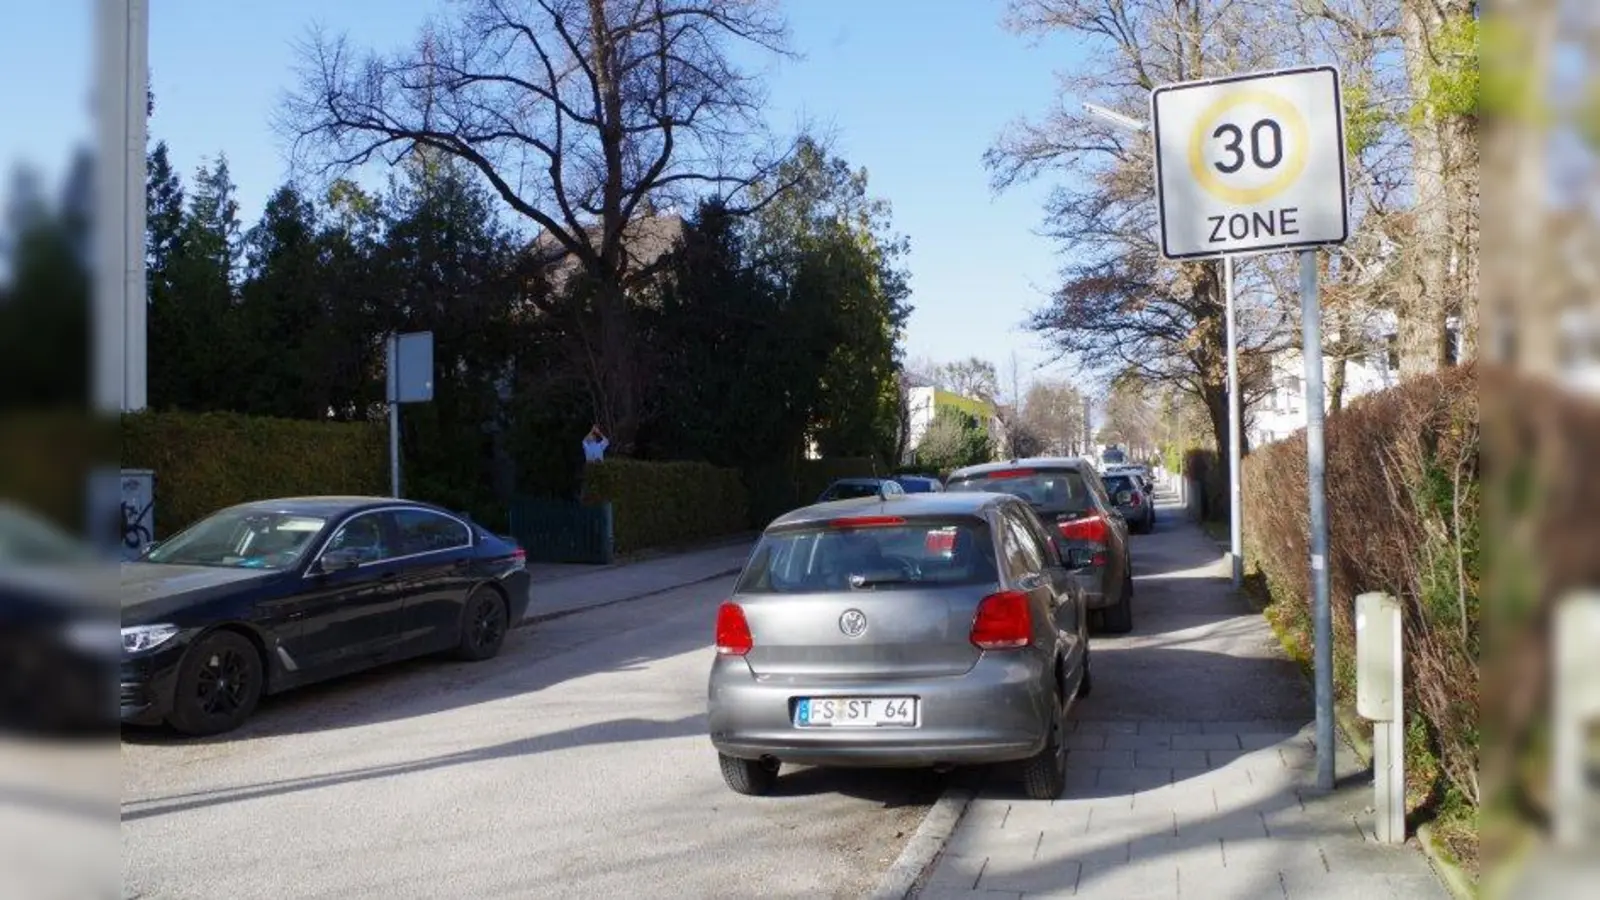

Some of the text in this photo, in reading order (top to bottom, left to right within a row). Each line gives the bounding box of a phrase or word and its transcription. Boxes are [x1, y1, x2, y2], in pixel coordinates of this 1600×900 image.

[1213, 118, 1283, 174] 30
[1207, 207, 1300, 243] ZONE
[811, 700, 908, 719] FS ST 64
